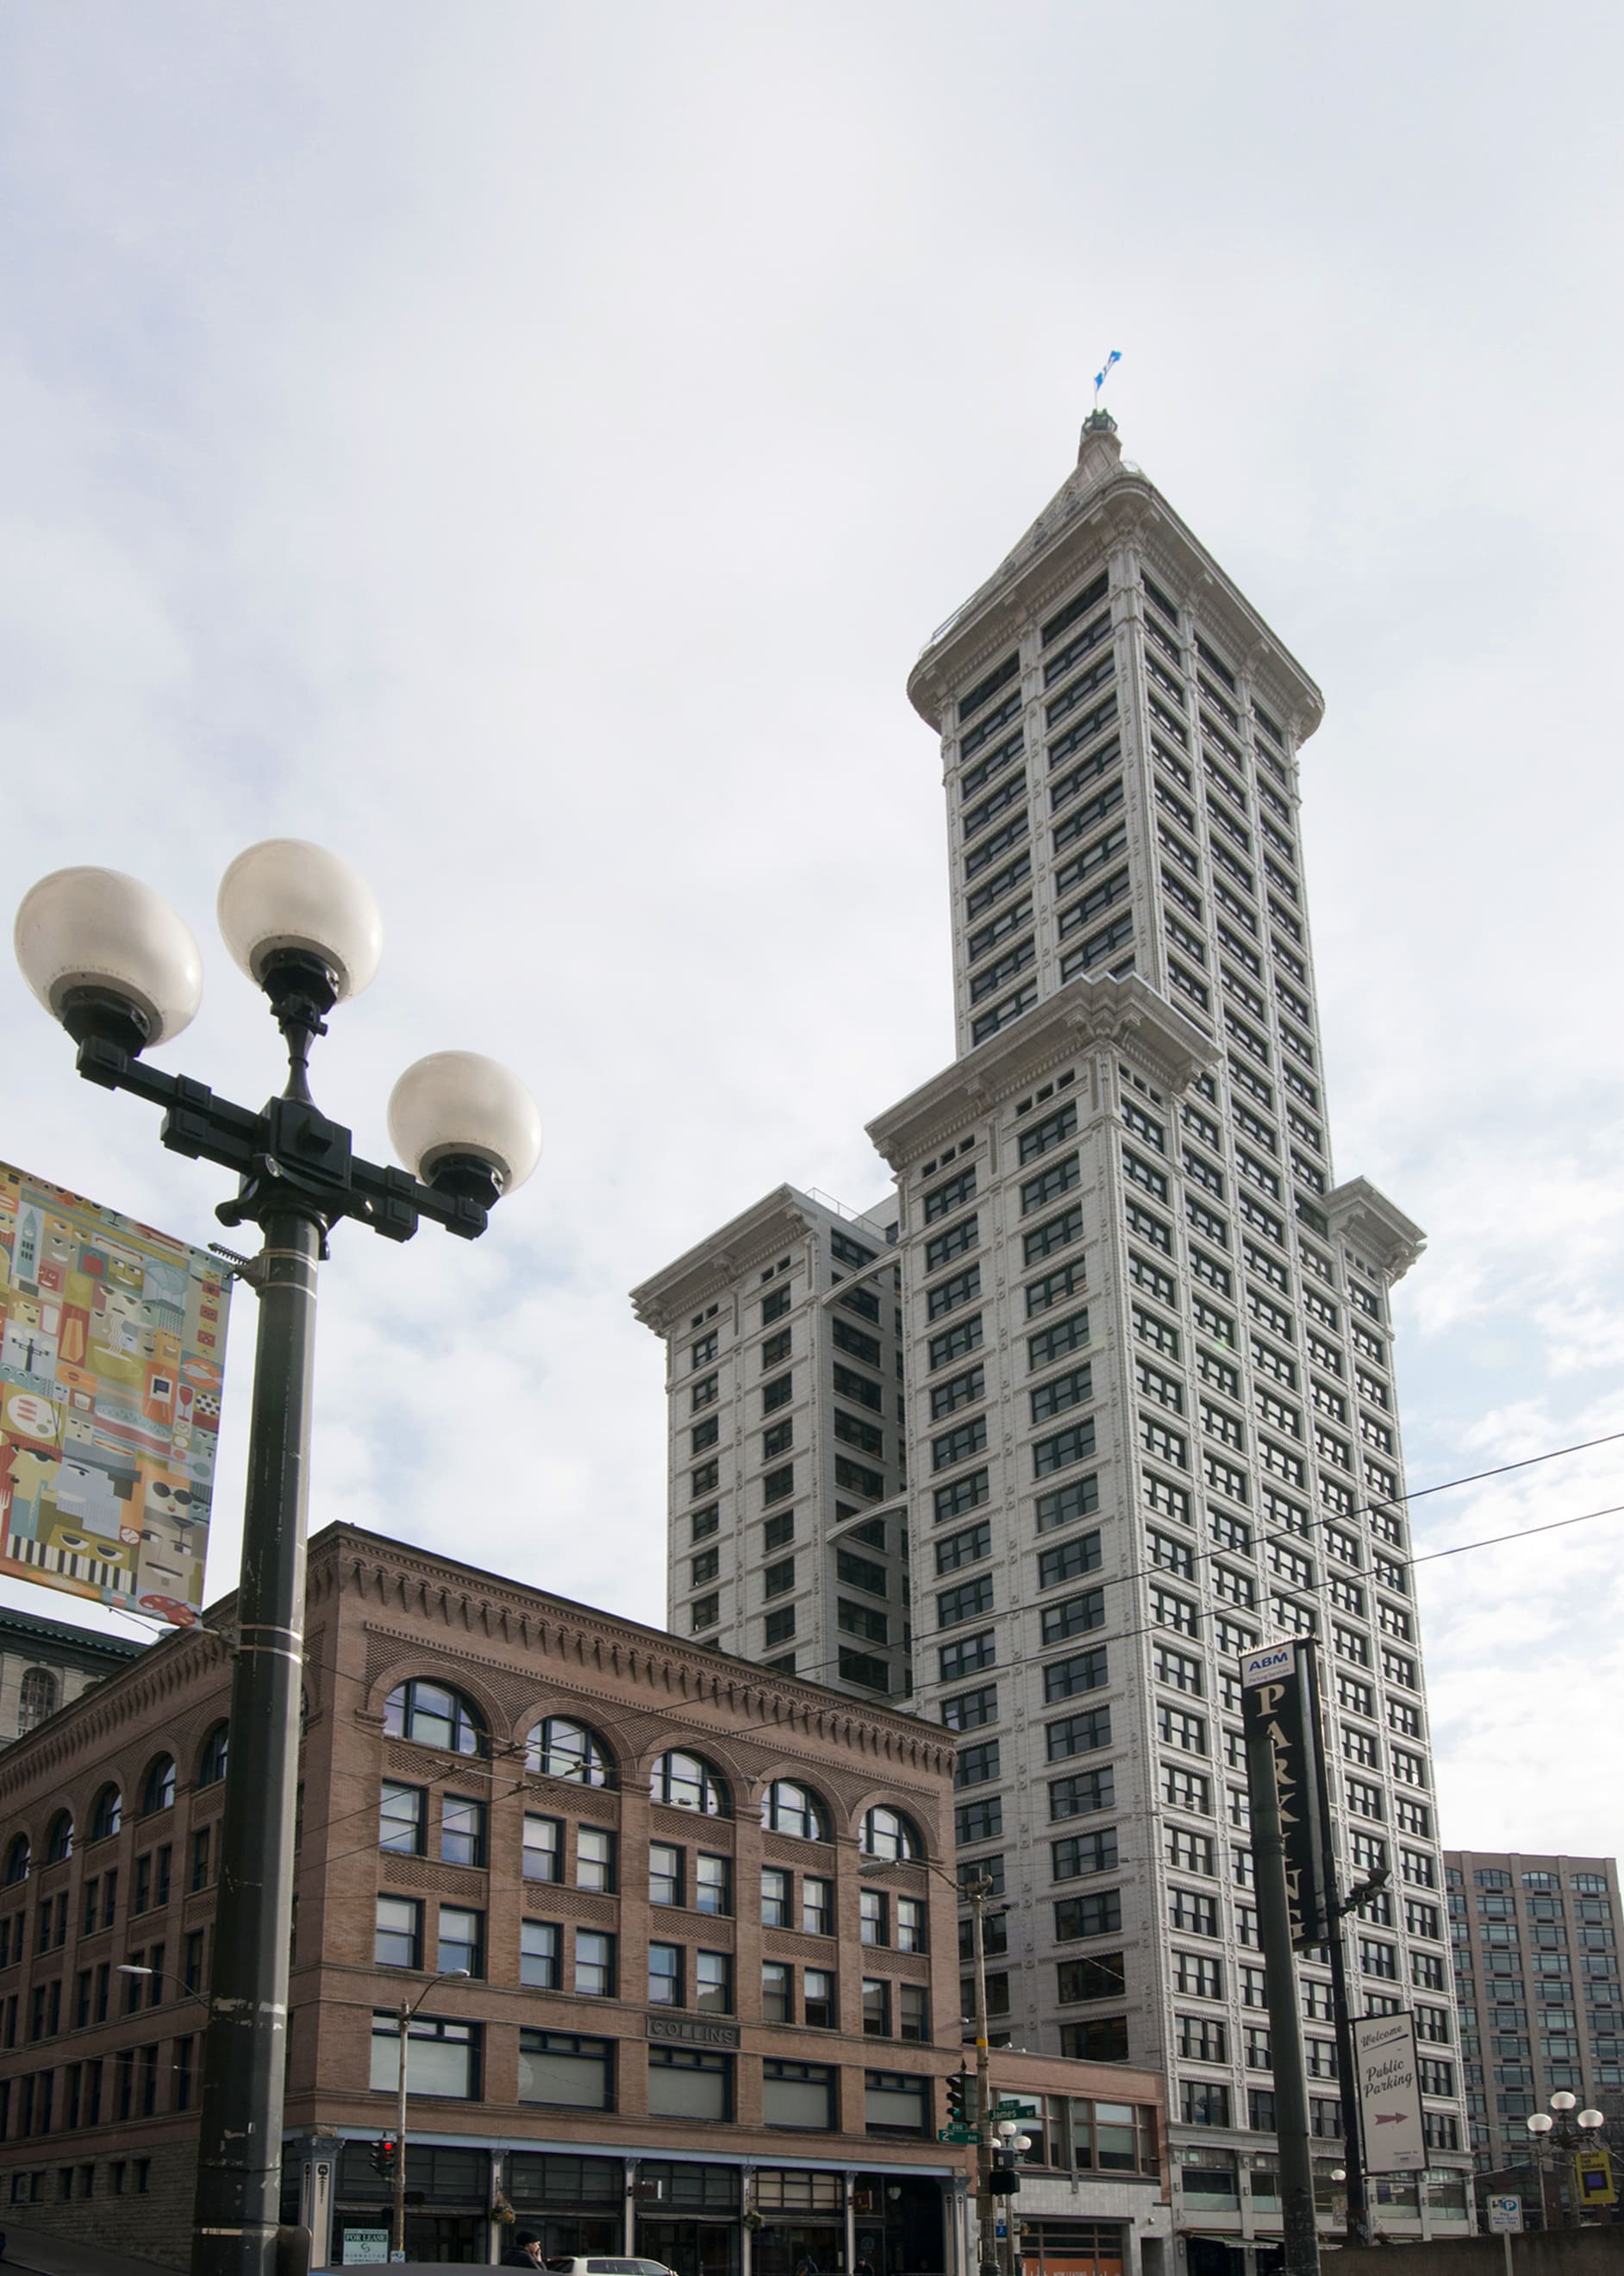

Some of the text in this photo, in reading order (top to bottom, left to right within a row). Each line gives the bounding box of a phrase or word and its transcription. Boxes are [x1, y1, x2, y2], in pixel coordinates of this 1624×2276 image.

[1248, 1652, 1288, 1672] ABM
[653, 2020, 733, 2044] COLLINS
[1361, 2025, 1403, 2048] Welcome
[1366, 2059, 1404, 2082] Public
[1364, 2072, 1413, 2098] Parking
[991, 2110, 1018, 2121] James
